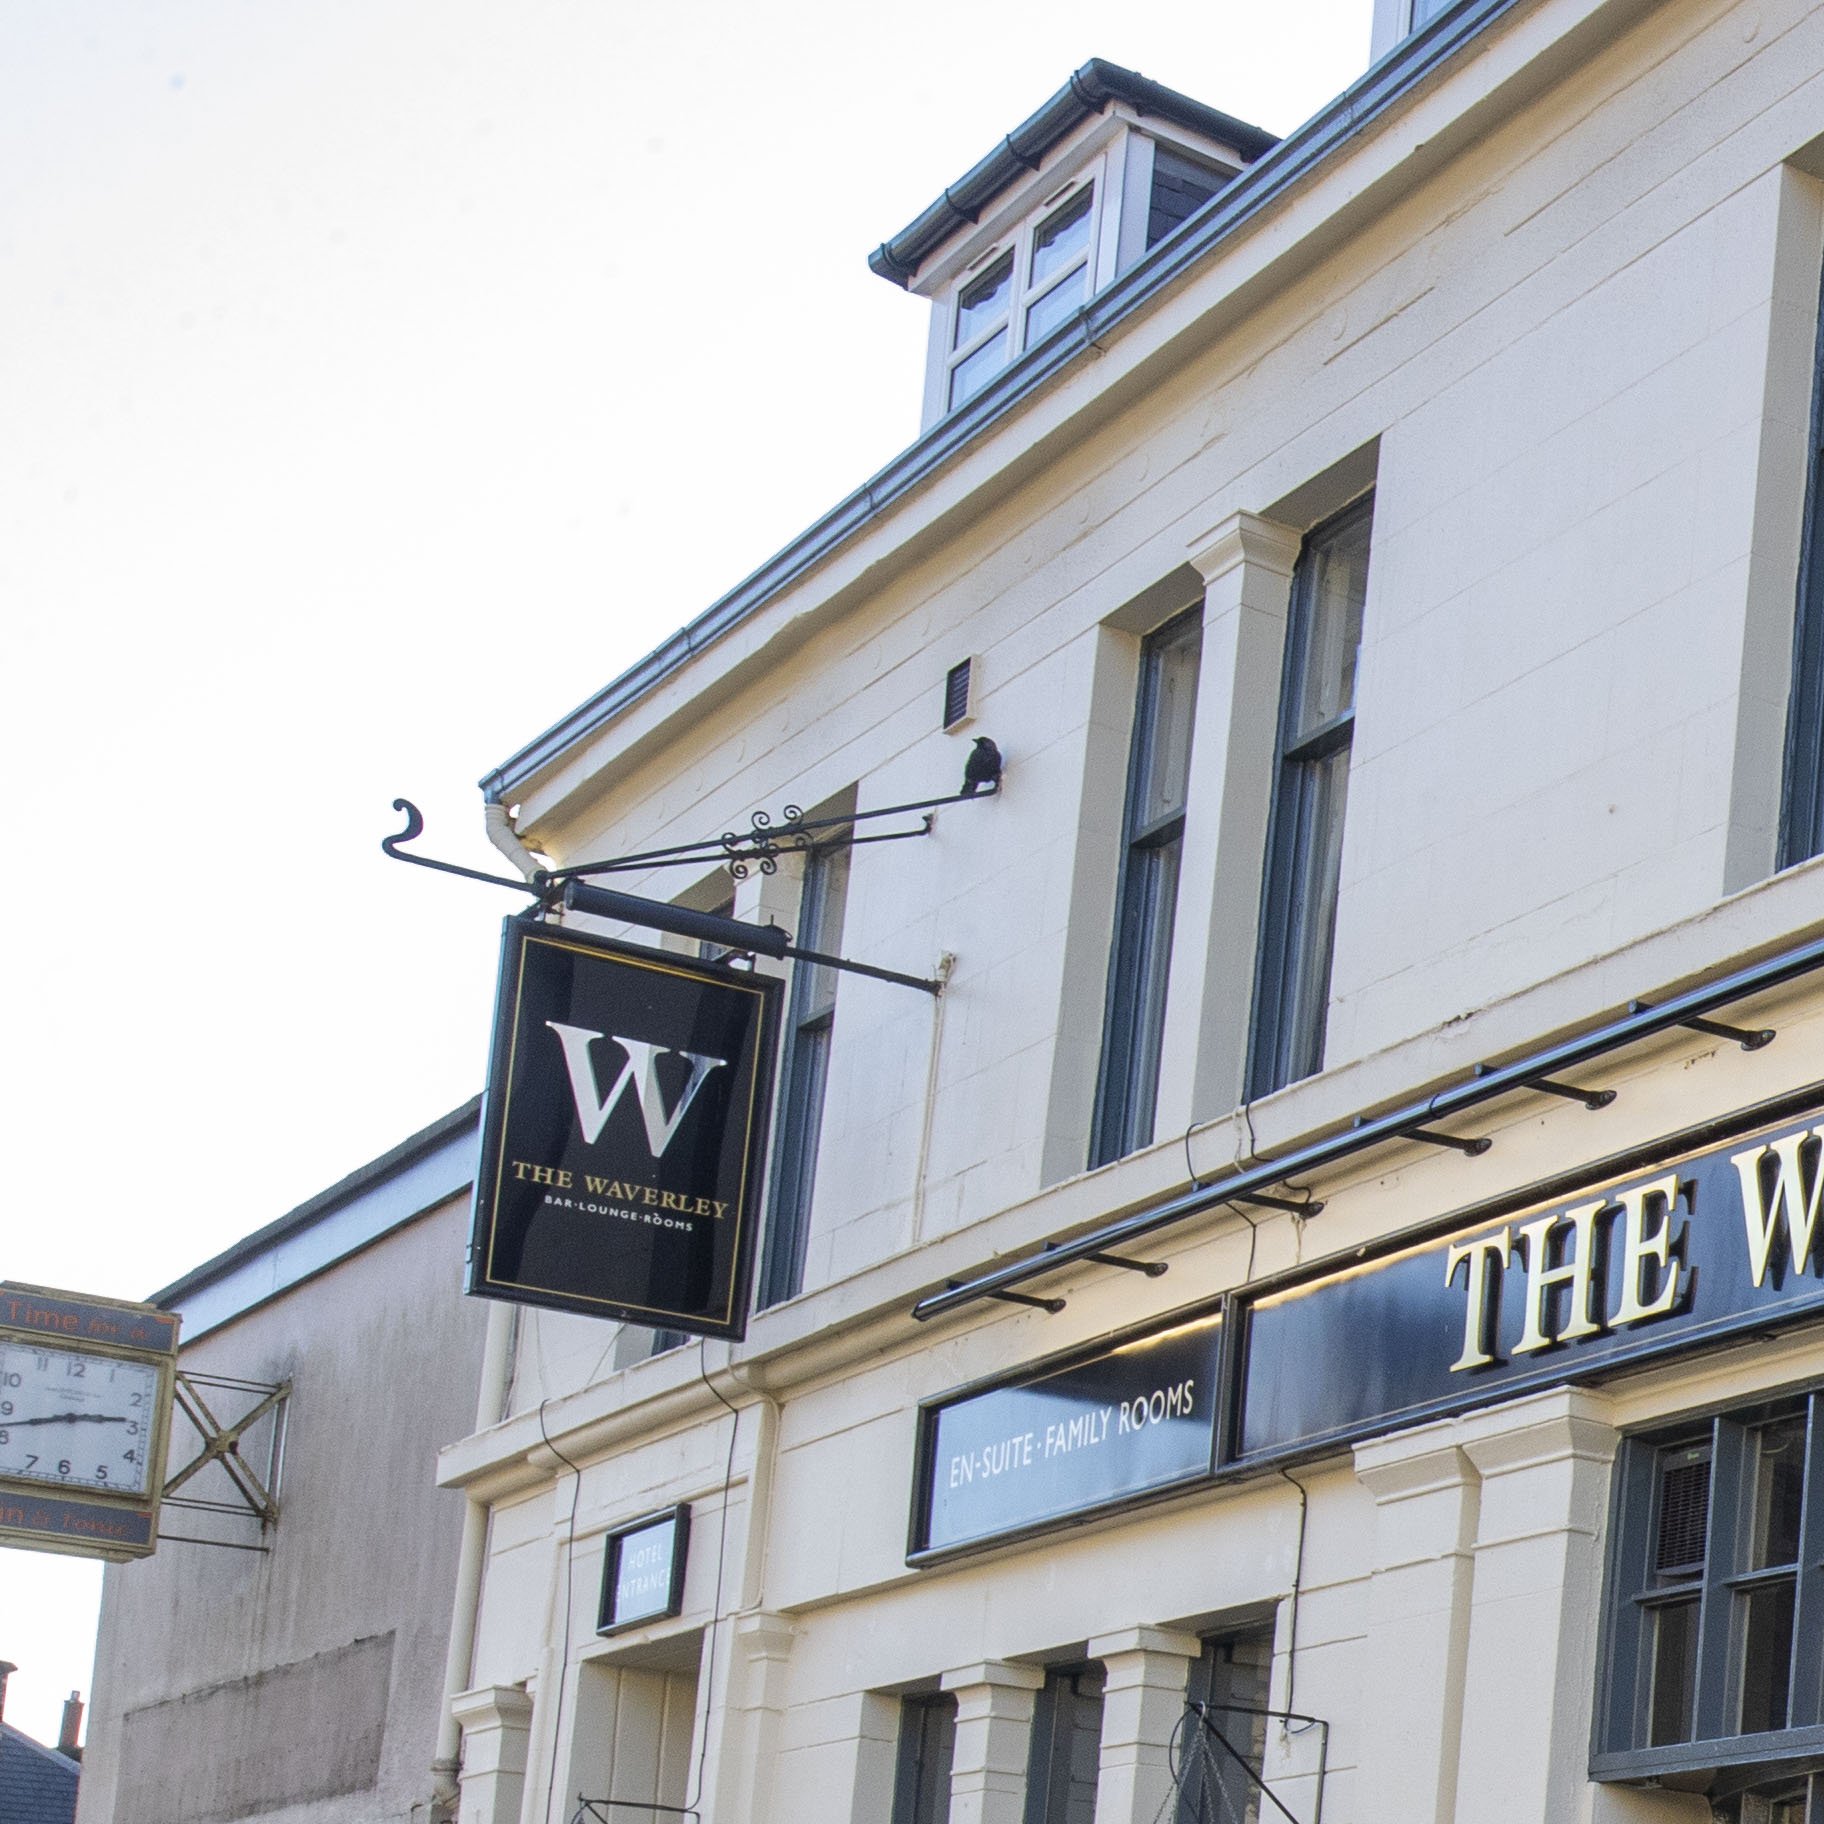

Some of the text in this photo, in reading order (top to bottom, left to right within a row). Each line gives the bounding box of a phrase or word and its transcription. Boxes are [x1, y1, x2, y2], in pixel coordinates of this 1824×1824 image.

[546, 1020, 729, 1158] W
[512, 1161, 729, 1220] THE WAVERLEY
[544, 1194, 694, 1232] BAR LOUNGE ROOMS
[1446, 1172, 1680, 1373] THE
[8, 1300, 81, 1331] Time
[67, 1358, 86, 1378] 12
[3, 1372, 21, 1387] 10
[1, 1401, 13, 1415] 9
[130, 1393, 142, 1407] 2
[126, 1420, 138, 1435] 3
[950, 1379, 1195, 1489] EN-SUITE FAMILY ROOMS
[26, 1454, 39, 1469] 7
[123, 1450, 136, 1463] 4
[58, 1460, 71, 1474] 6
[95, 1465, 108, 1479] 5
[628, 1544, 662, 1569] HOTEL
